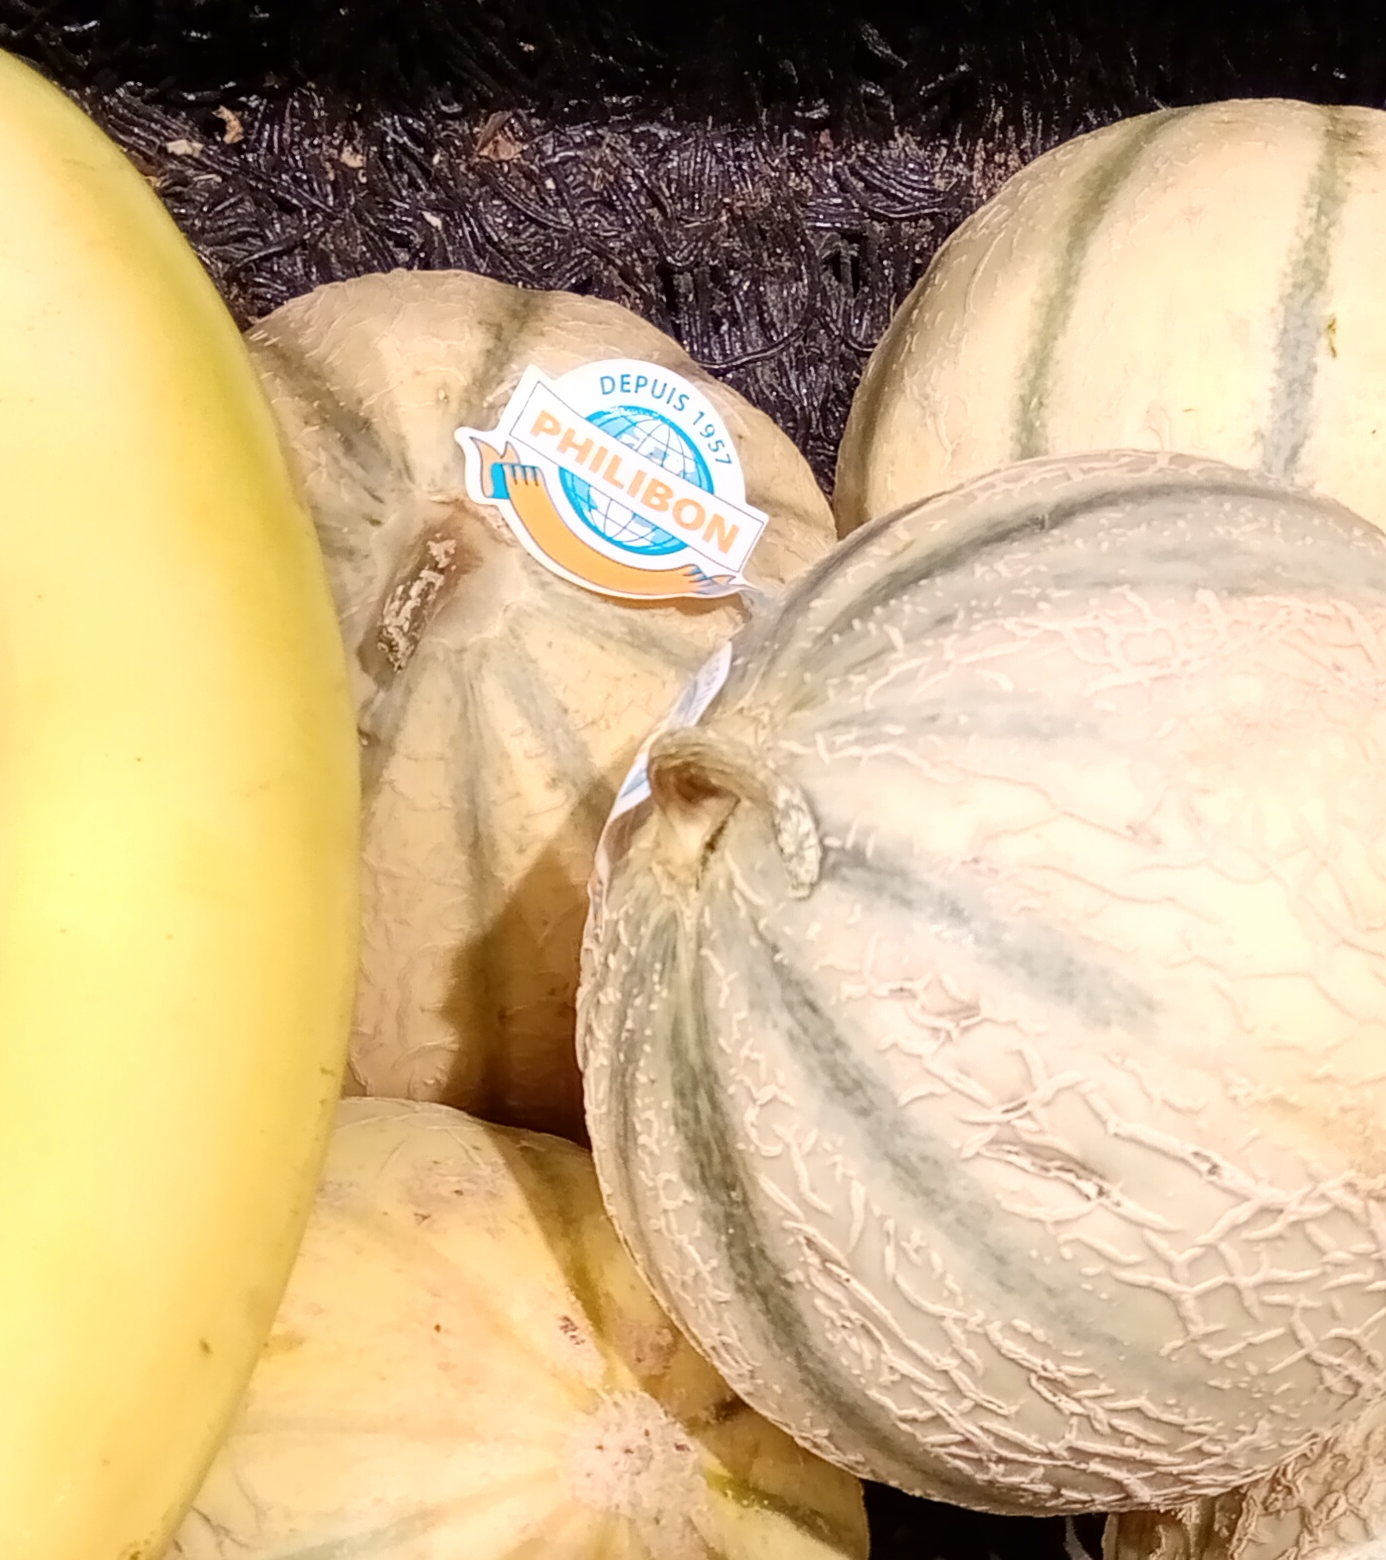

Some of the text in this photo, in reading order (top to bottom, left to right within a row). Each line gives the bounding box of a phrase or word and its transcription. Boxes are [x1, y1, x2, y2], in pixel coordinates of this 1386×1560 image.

[600, 374, 733, 466] DEPUIS 1957
[528, 409, 740, 555] PHILIBON
